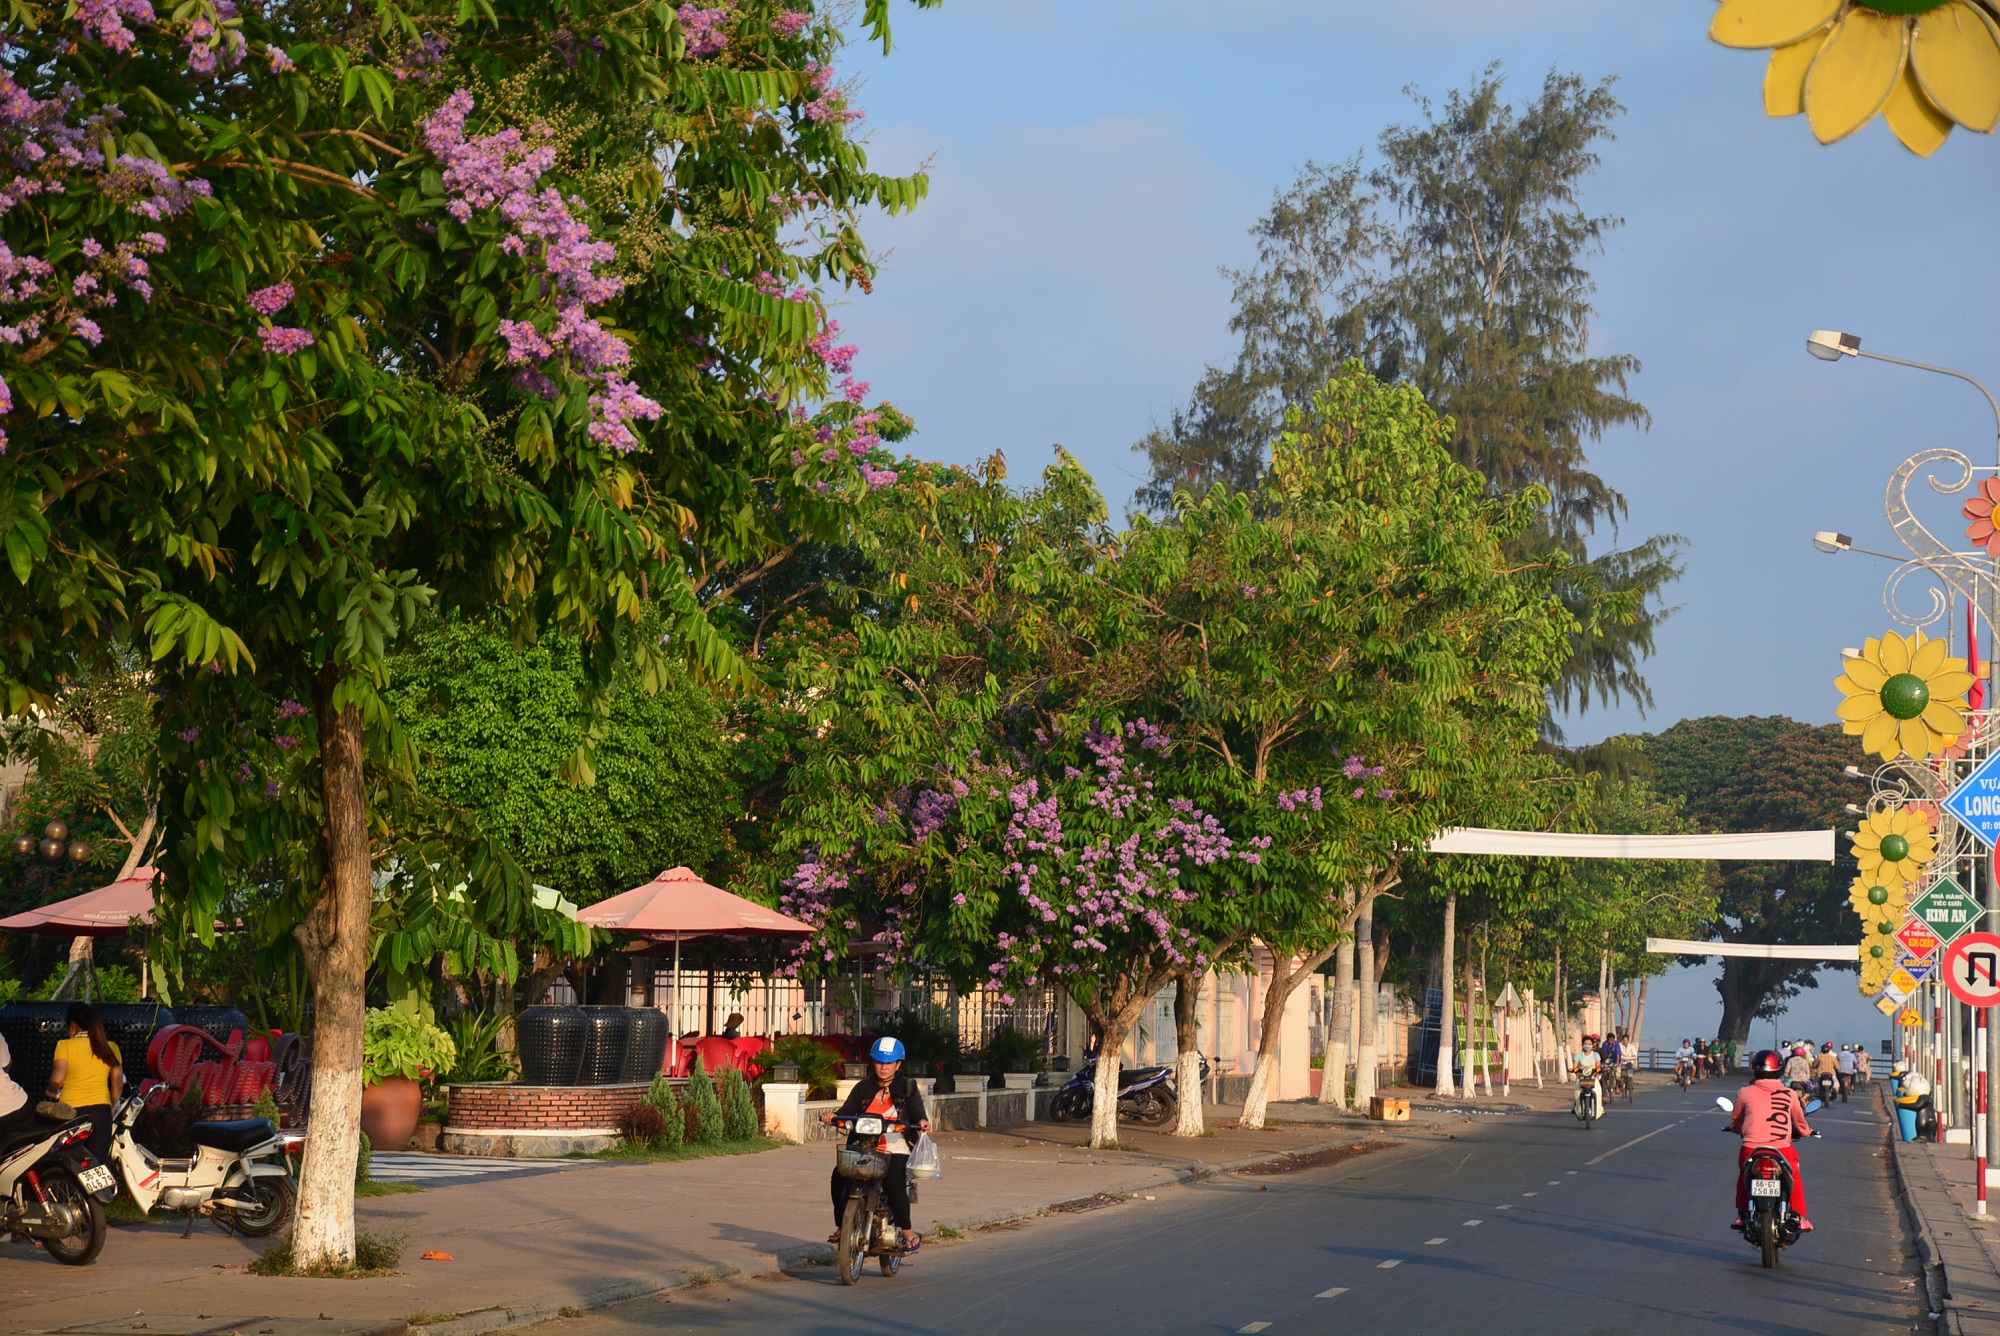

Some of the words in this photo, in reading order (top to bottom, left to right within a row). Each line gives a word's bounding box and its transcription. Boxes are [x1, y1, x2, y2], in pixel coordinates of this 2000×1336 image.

[1965, 796, 2000, 816] LONG
[1926, 908, 1949, 922] KIM
[1951, 909, 1967, 923] AN
